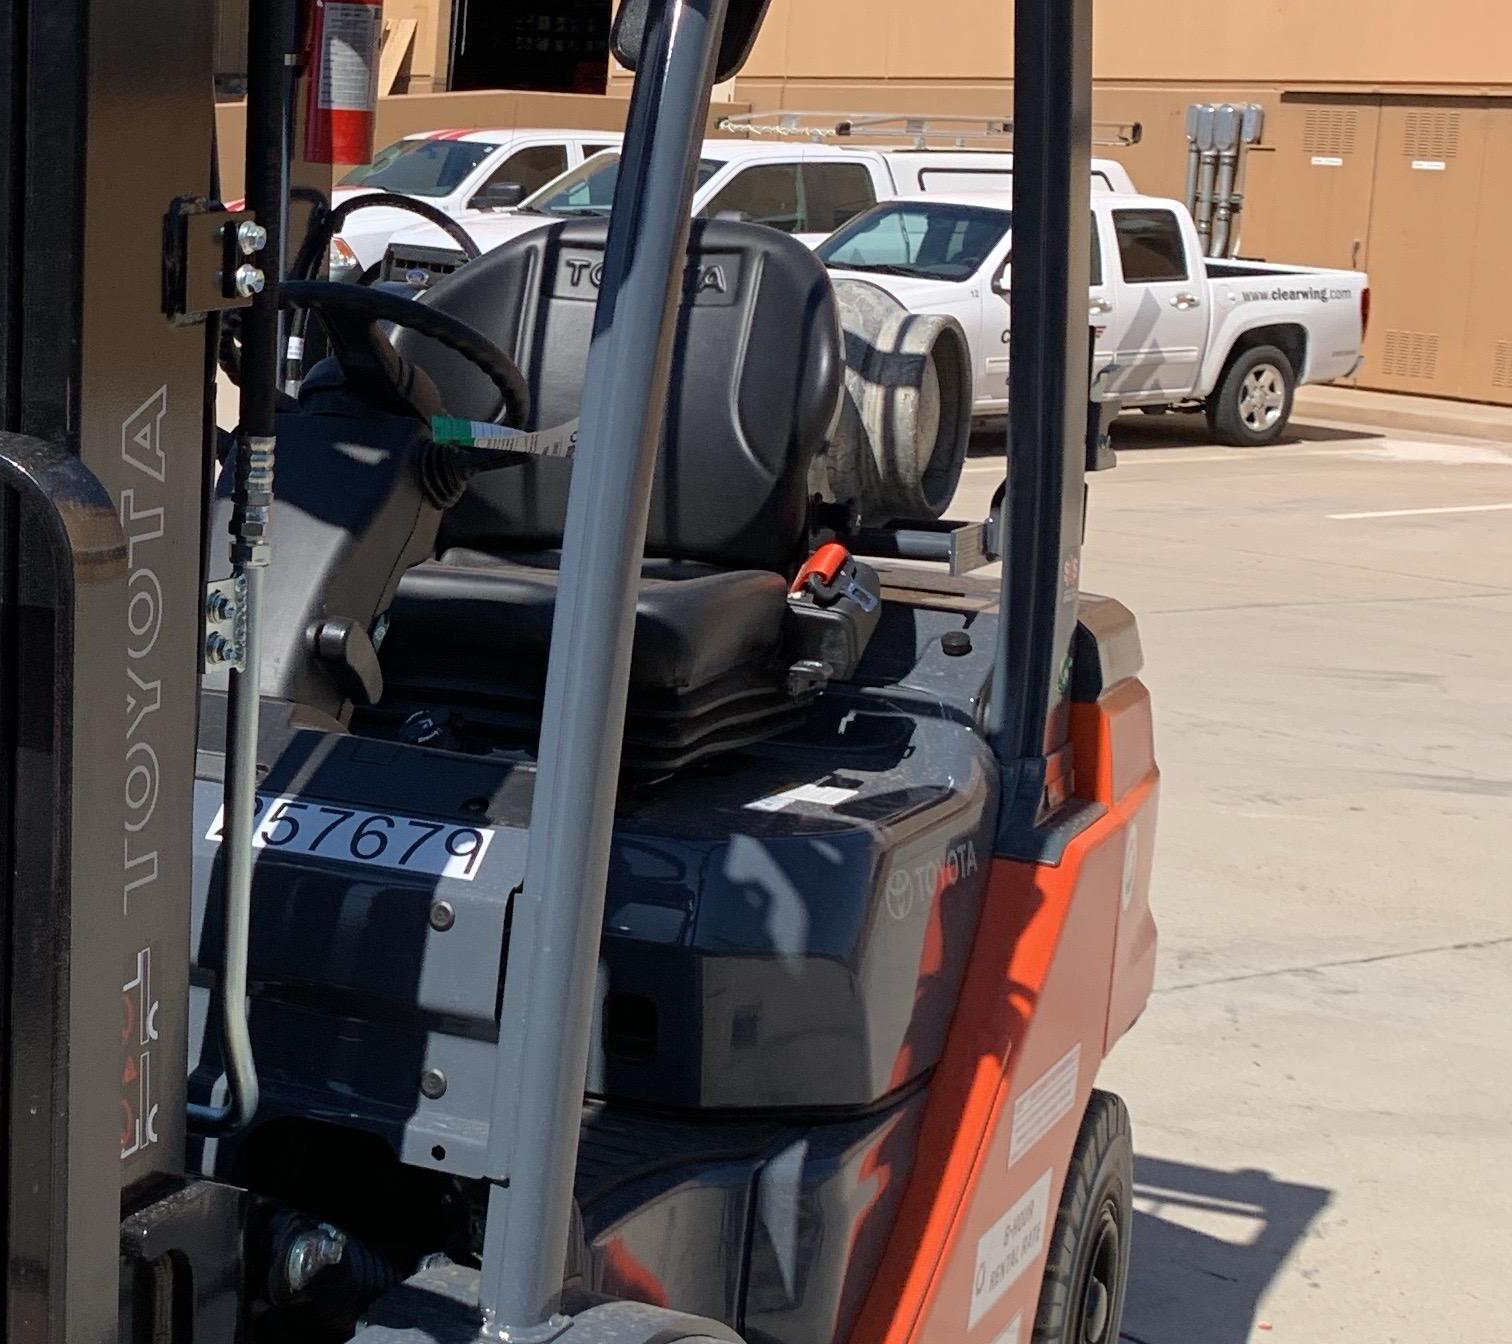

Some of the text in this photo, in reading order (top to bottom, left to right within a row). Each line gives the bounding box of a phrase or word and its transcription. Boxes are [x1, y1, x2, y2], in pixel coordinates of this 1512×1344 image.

[1242, 286, 1353, 304] www.clearwing.com
[121, 383, 168, 918] TOYOTA
[214, 794, 485, 875] 57679
[915, 839, 979, 903] TOYOTA
